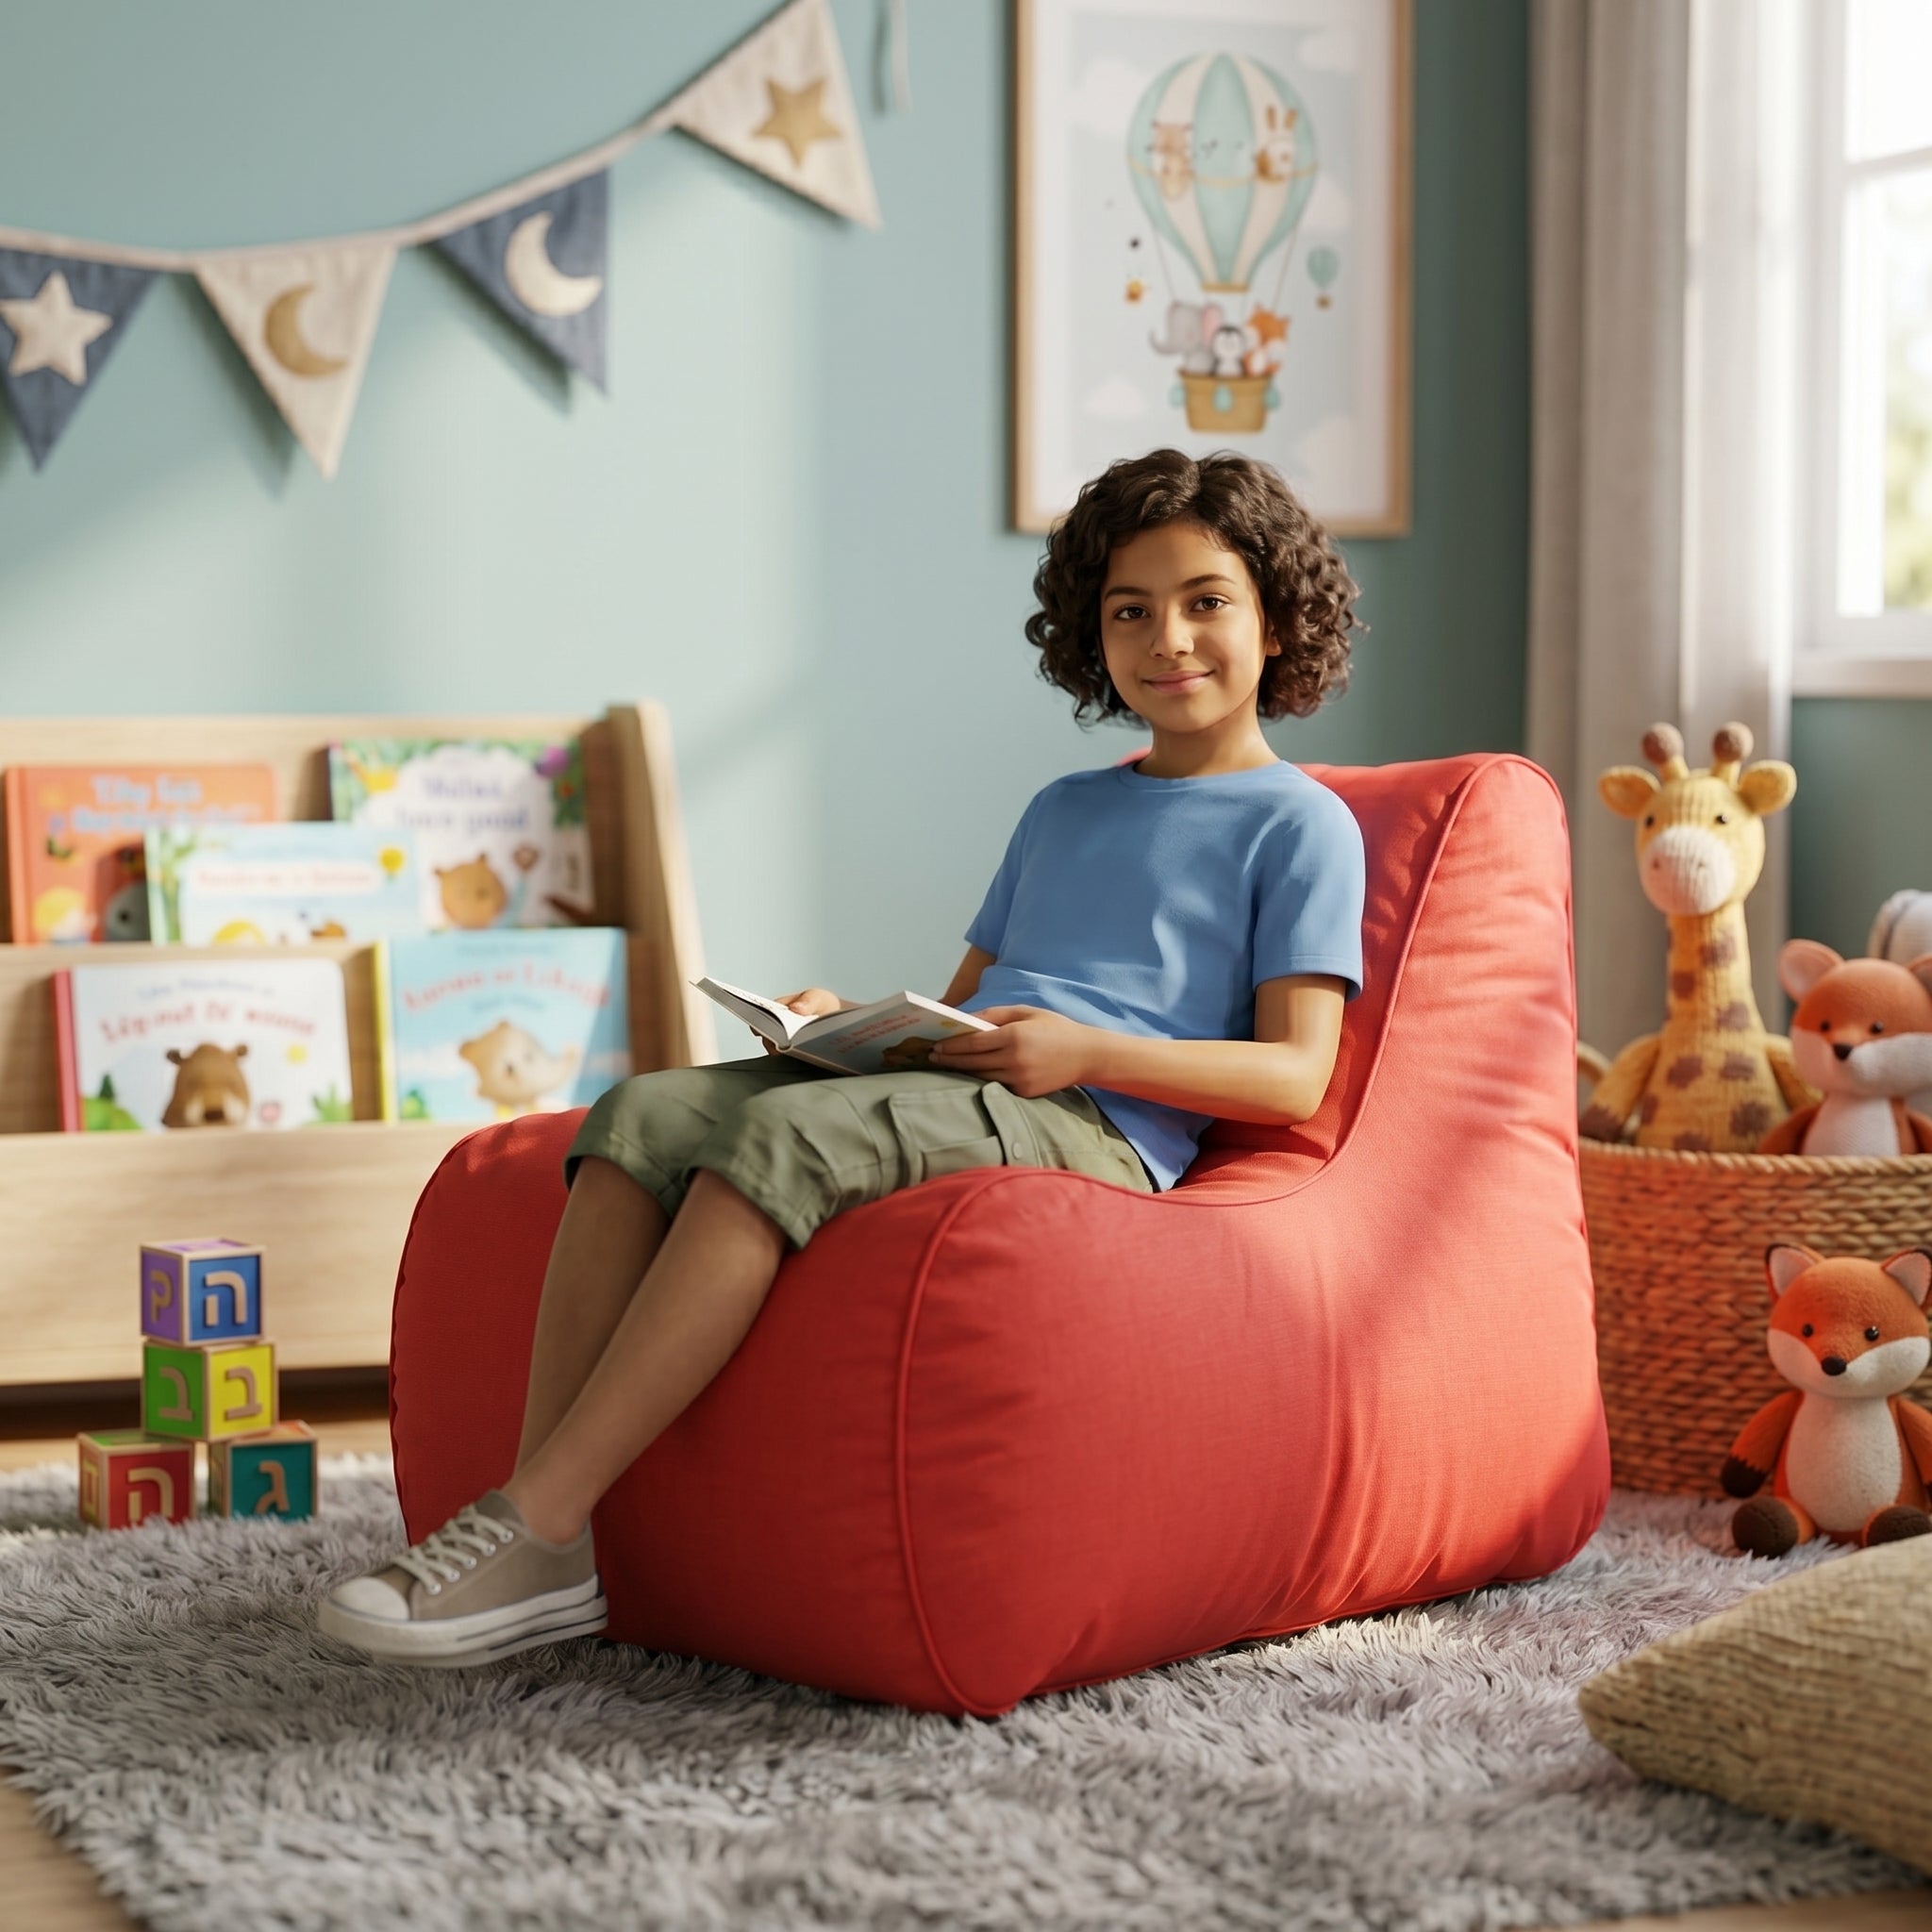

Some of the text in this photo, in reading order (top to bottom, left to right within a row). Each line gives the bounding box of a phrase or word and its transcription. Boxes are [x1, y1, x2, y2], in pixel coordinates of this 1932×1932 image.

[205, 1270, 247, 1326] ה
[158, 1366, 193, 1422] ב
[224, 1365, 262, 1422] ב
[127, 1466, 174, 1523] ה
[255, 1459, 291, 1515] ג
